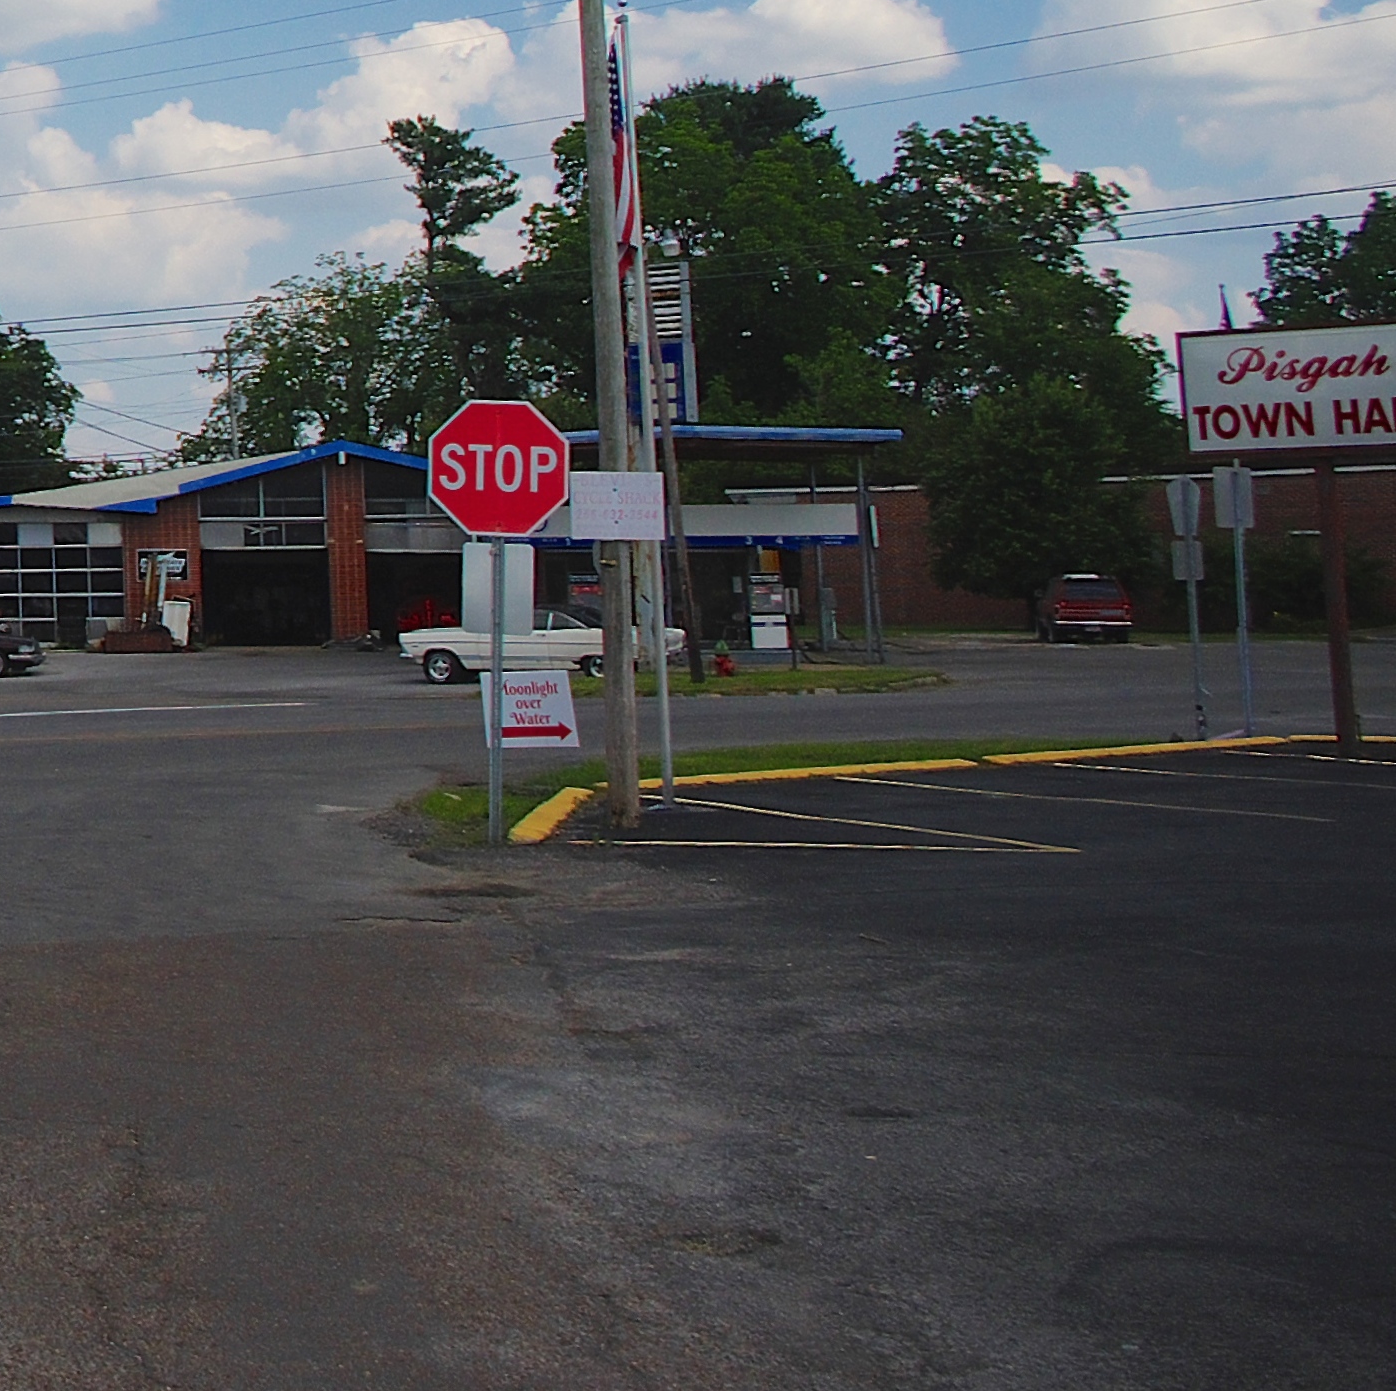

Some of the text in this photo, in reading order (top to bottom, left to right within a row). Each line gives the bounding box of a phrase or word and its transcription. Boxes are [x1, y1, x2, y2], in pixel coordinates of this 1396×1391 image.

[1217, 343, 1391, 393] Pisgah
[1192, 396, 1396, 440] TOWN HA
[438, 442, 558, 493] STOP
[509, 711, 551, 725] Water
[515, 699, 542, 709] over
